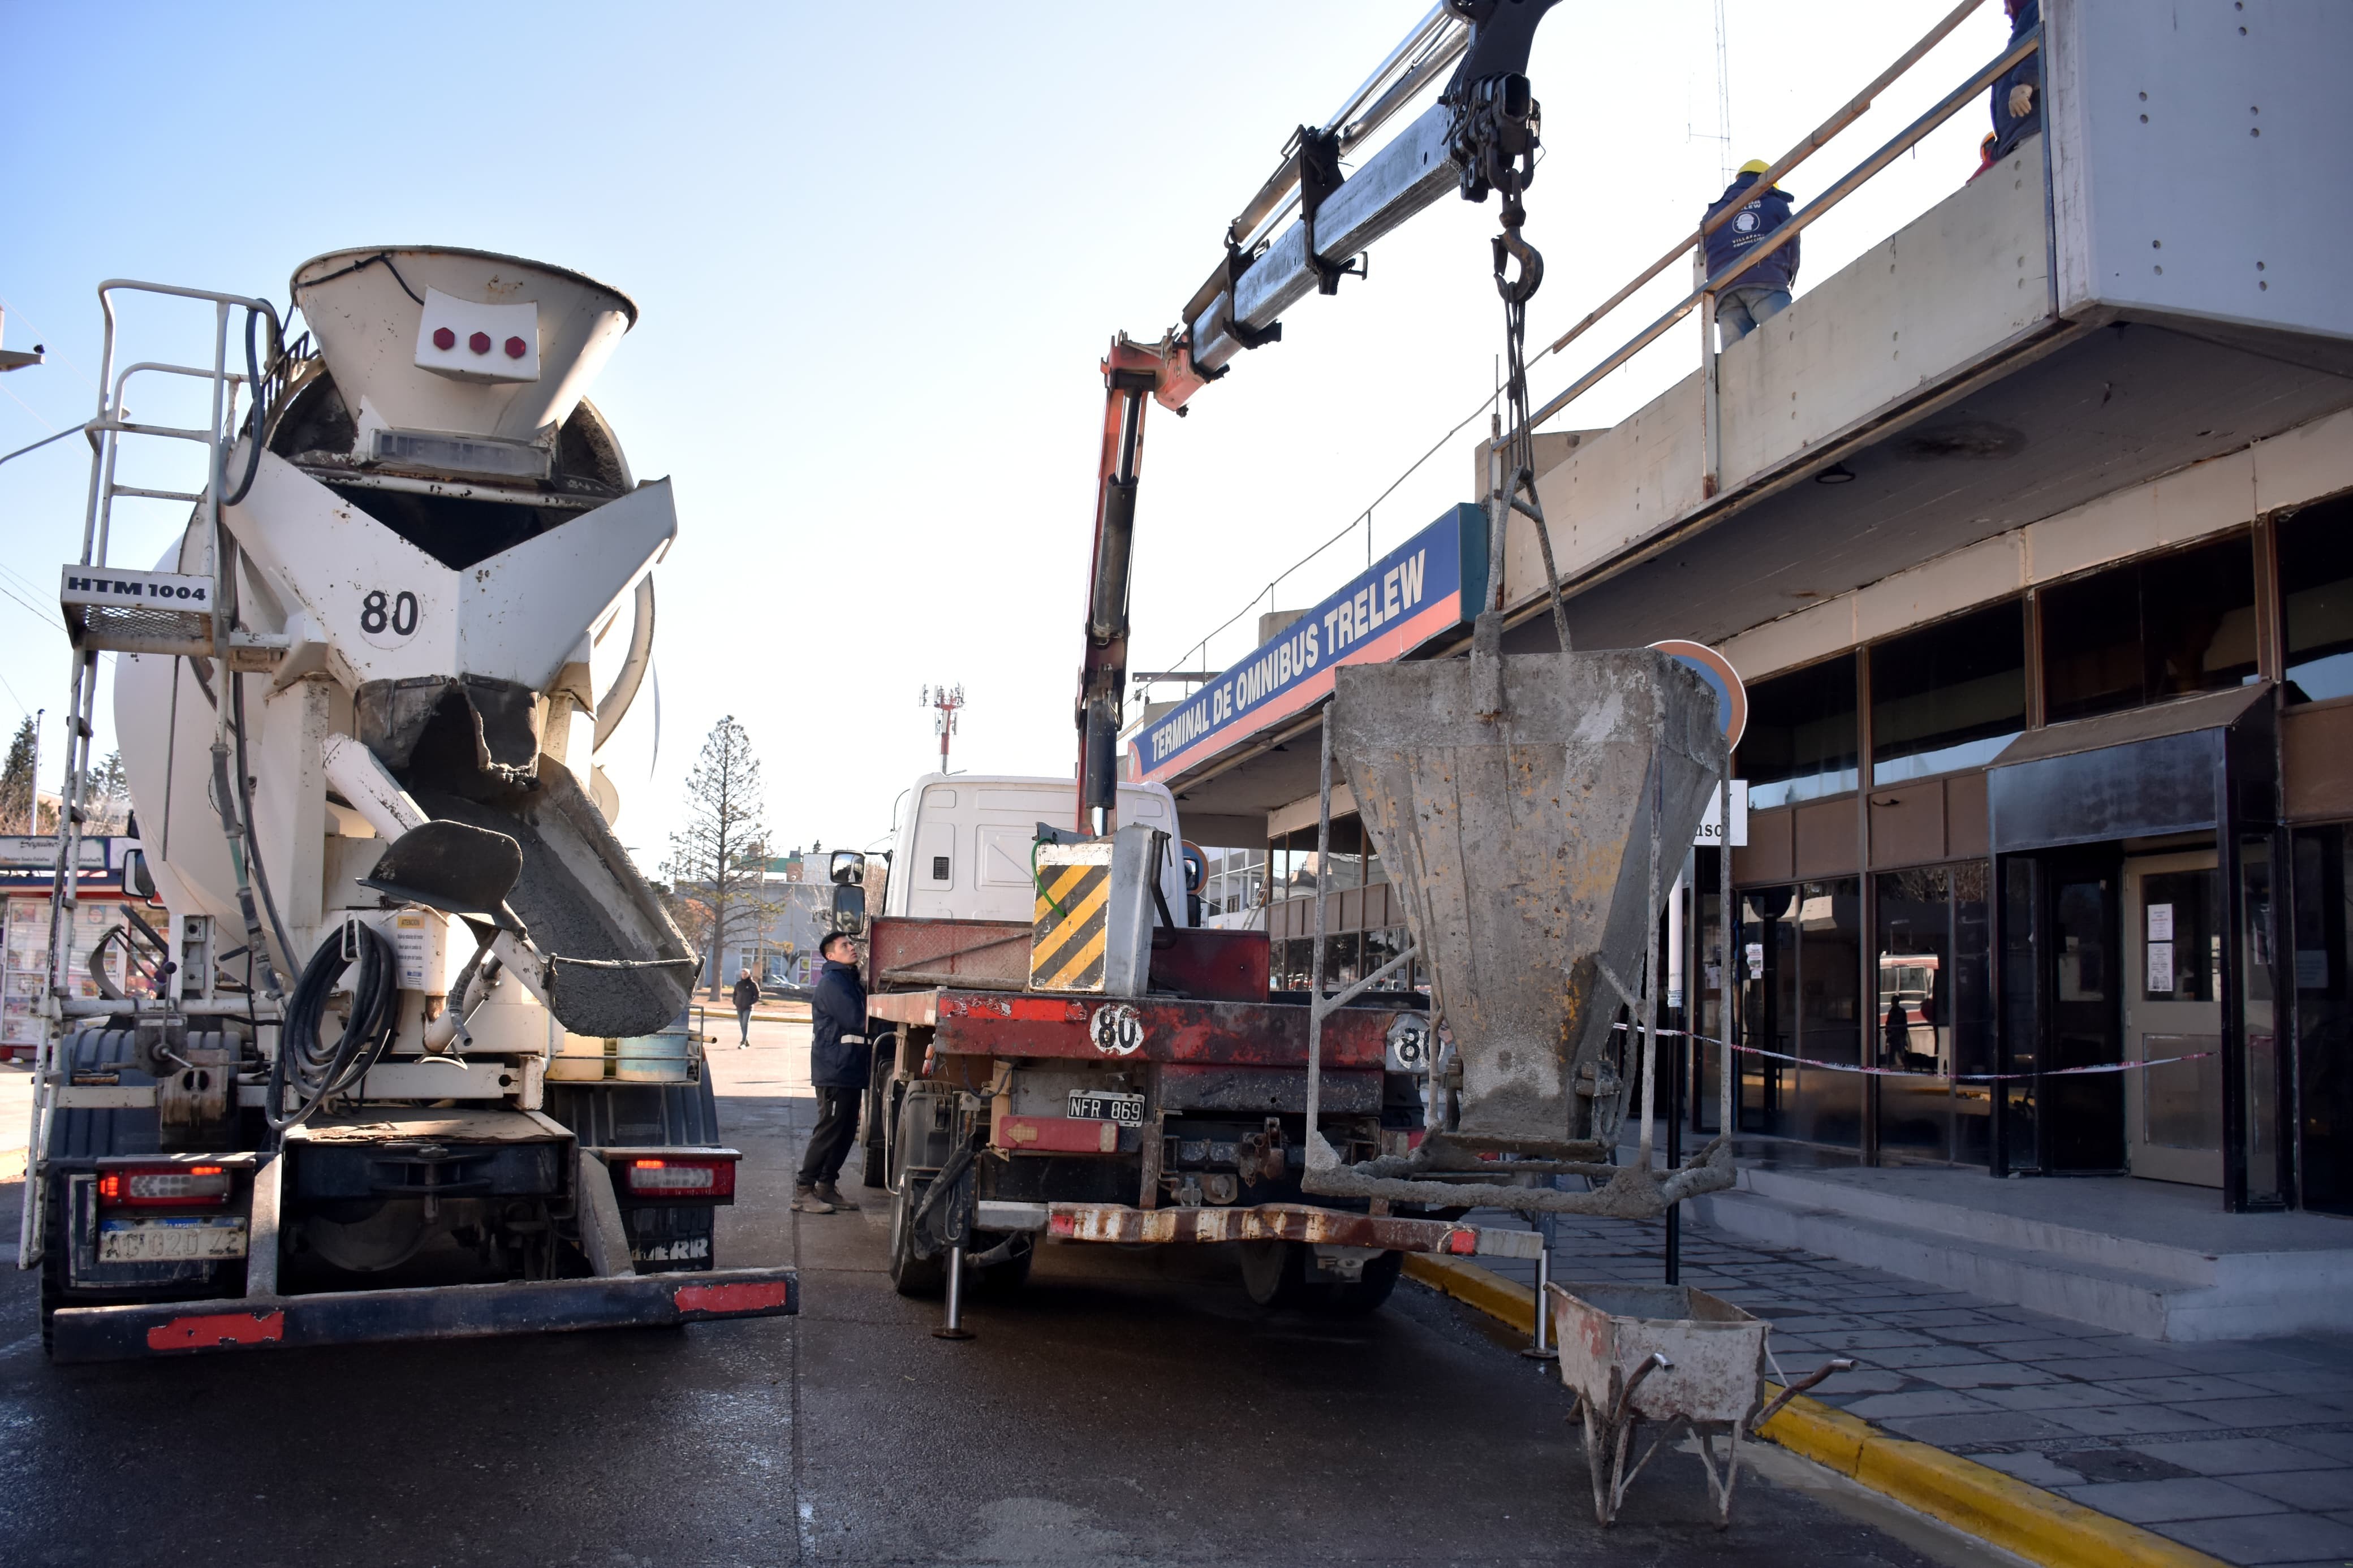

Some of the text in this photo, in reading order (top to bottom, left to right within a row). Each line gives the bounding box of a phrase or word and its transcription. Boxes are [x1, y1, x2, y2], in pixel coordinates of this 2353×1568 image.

[68, 577, 206, 601] HTM 1004
[361, 590, 418, 636] 80
[1152, 548, 1425, 762] TERMINAL DE OMNIBUS TRELEW
[1098, 1008, 1136, 1049] 80
[1071, 1098, 1140, 1121] NFR 869
